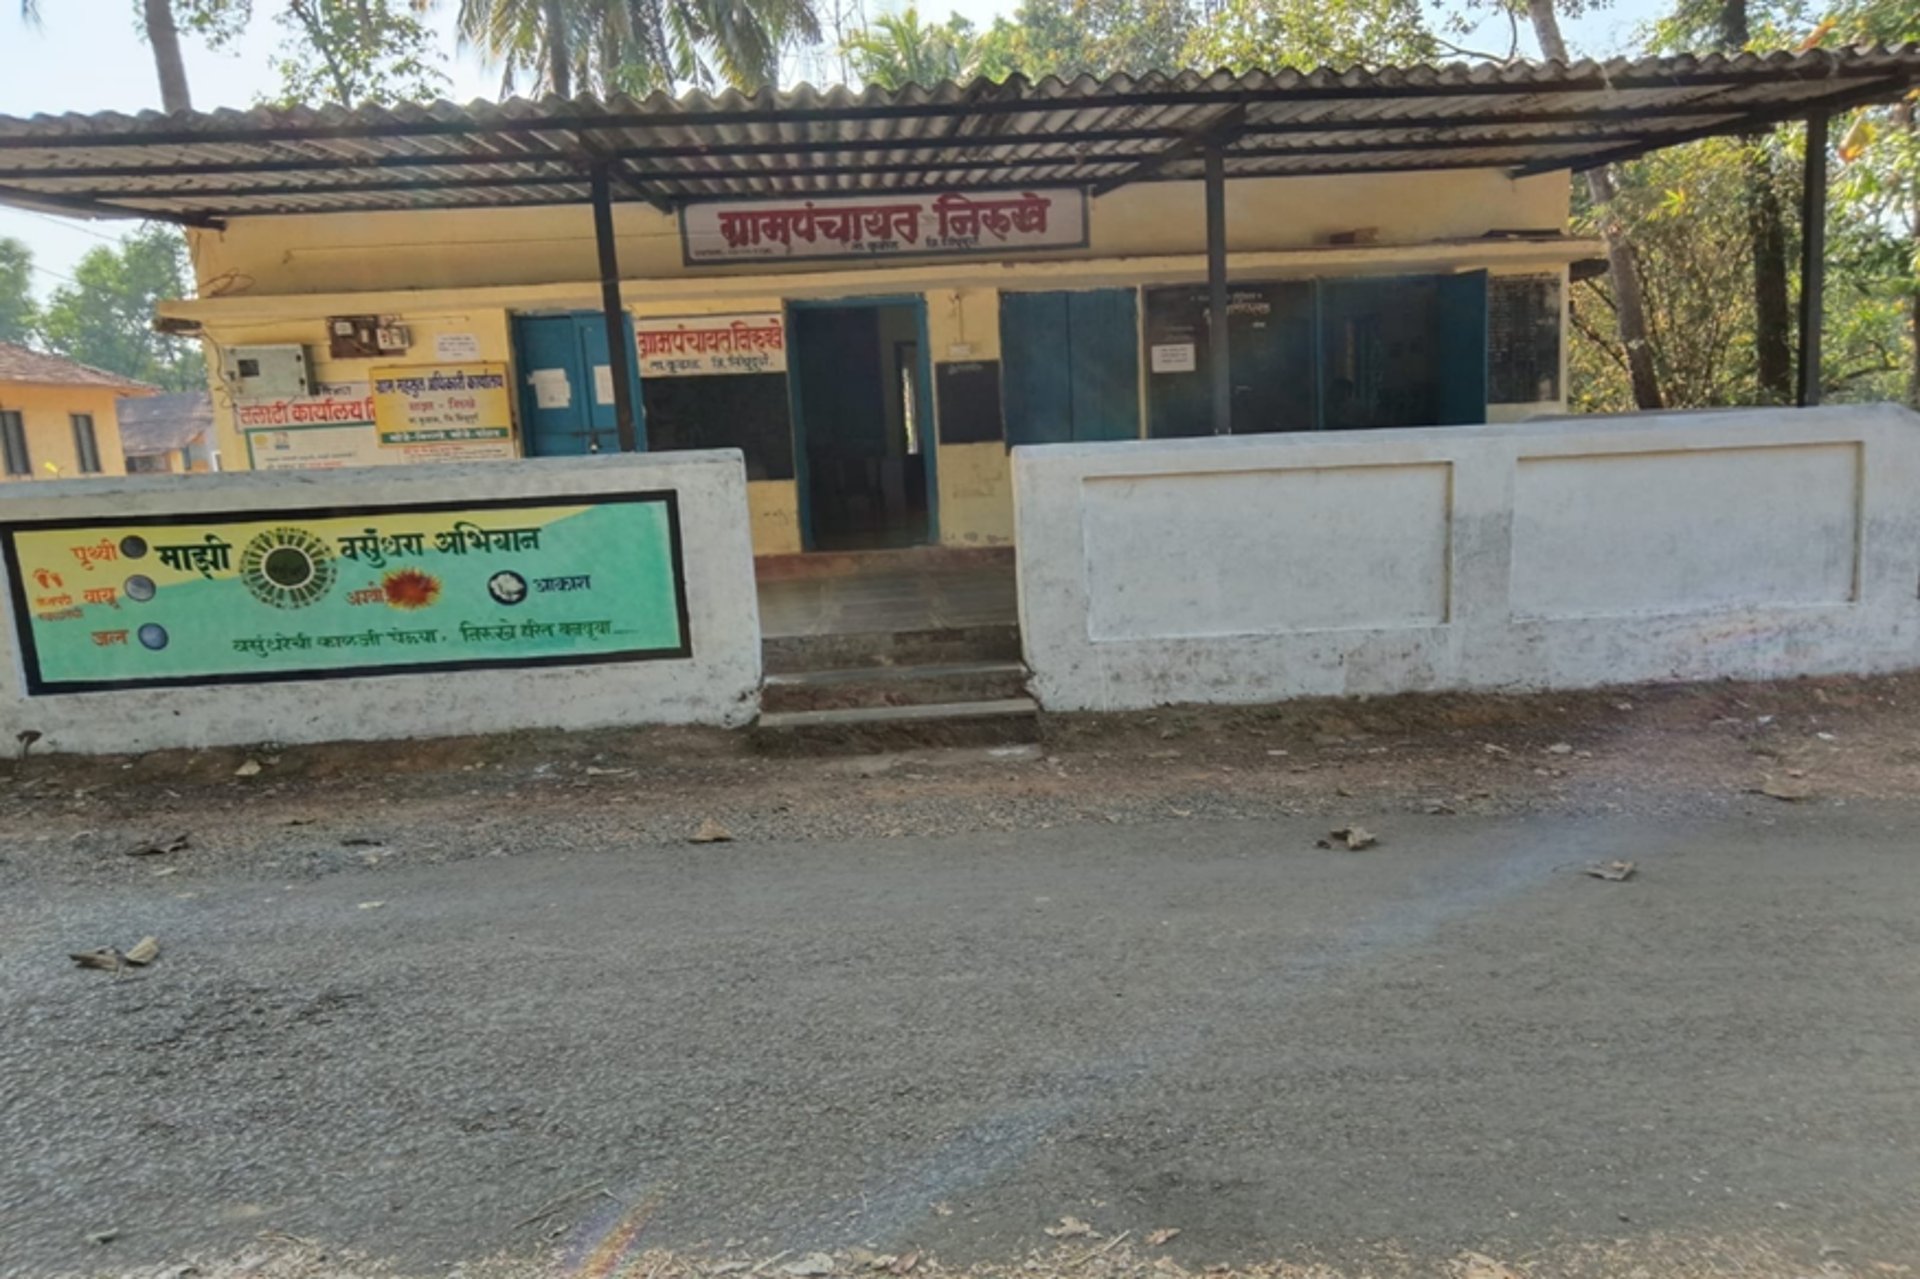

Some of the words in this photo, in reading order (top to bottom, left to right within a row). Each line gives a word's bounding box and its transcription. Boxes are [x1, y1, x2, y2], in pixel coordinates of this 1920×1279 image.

[718, 201, 922, 246] ग्रामपंचायत
[932, 192, 1052, 240] निरुखे
[637, 323, 731, 358] ग्रामपंचायत
[731, 317, 783, 353] निरुखे
[240, 400, 288, 424] तलाठी
[292, 397, 362, 423] कार्यालय
[70, 537, 118, 571] पृथ्वी
[153, 533, 232, 580] माझी
[434, 521, 542, 555] अभियान
[533, 574, 592, 593] आकाश
[316, 629, 383, 647] काळजी
